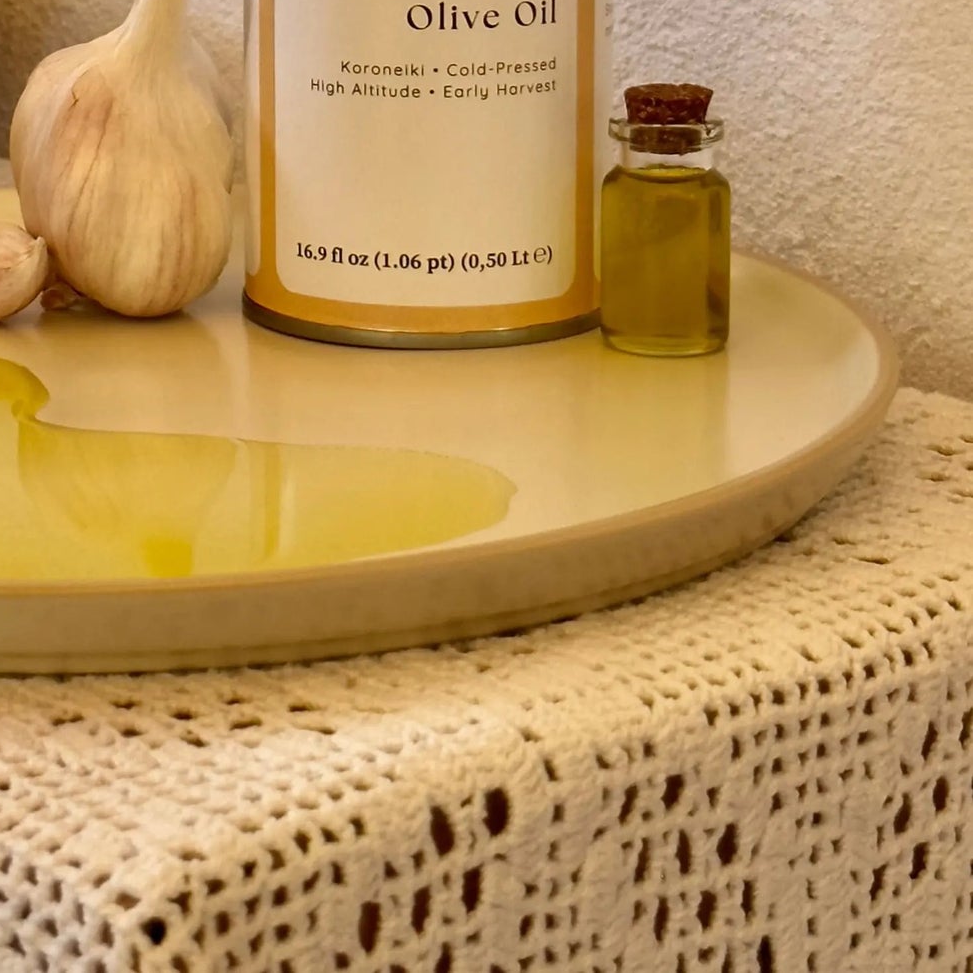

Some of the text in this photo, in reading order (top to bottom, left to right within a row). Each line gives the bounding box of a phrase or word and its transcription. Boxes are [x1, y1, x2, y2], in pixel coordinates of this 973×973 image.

[406, 1, 500, 31] Olive
[340, 56, 557, 77] Koroneiki Cold-Pressed
[310, 78, 557, 101] High Altitude Early Harvest
[296, 242, 328, 262] 16.9
[330, 246, 344, 265] fl
[347, 253, 370, 267] oz
[373, 250, 422, 272] (1.06
[426, 252, 456, 275] pt)
[460, 251, 508, 273] (0,50
[511, 250, 530, 266] Lt
